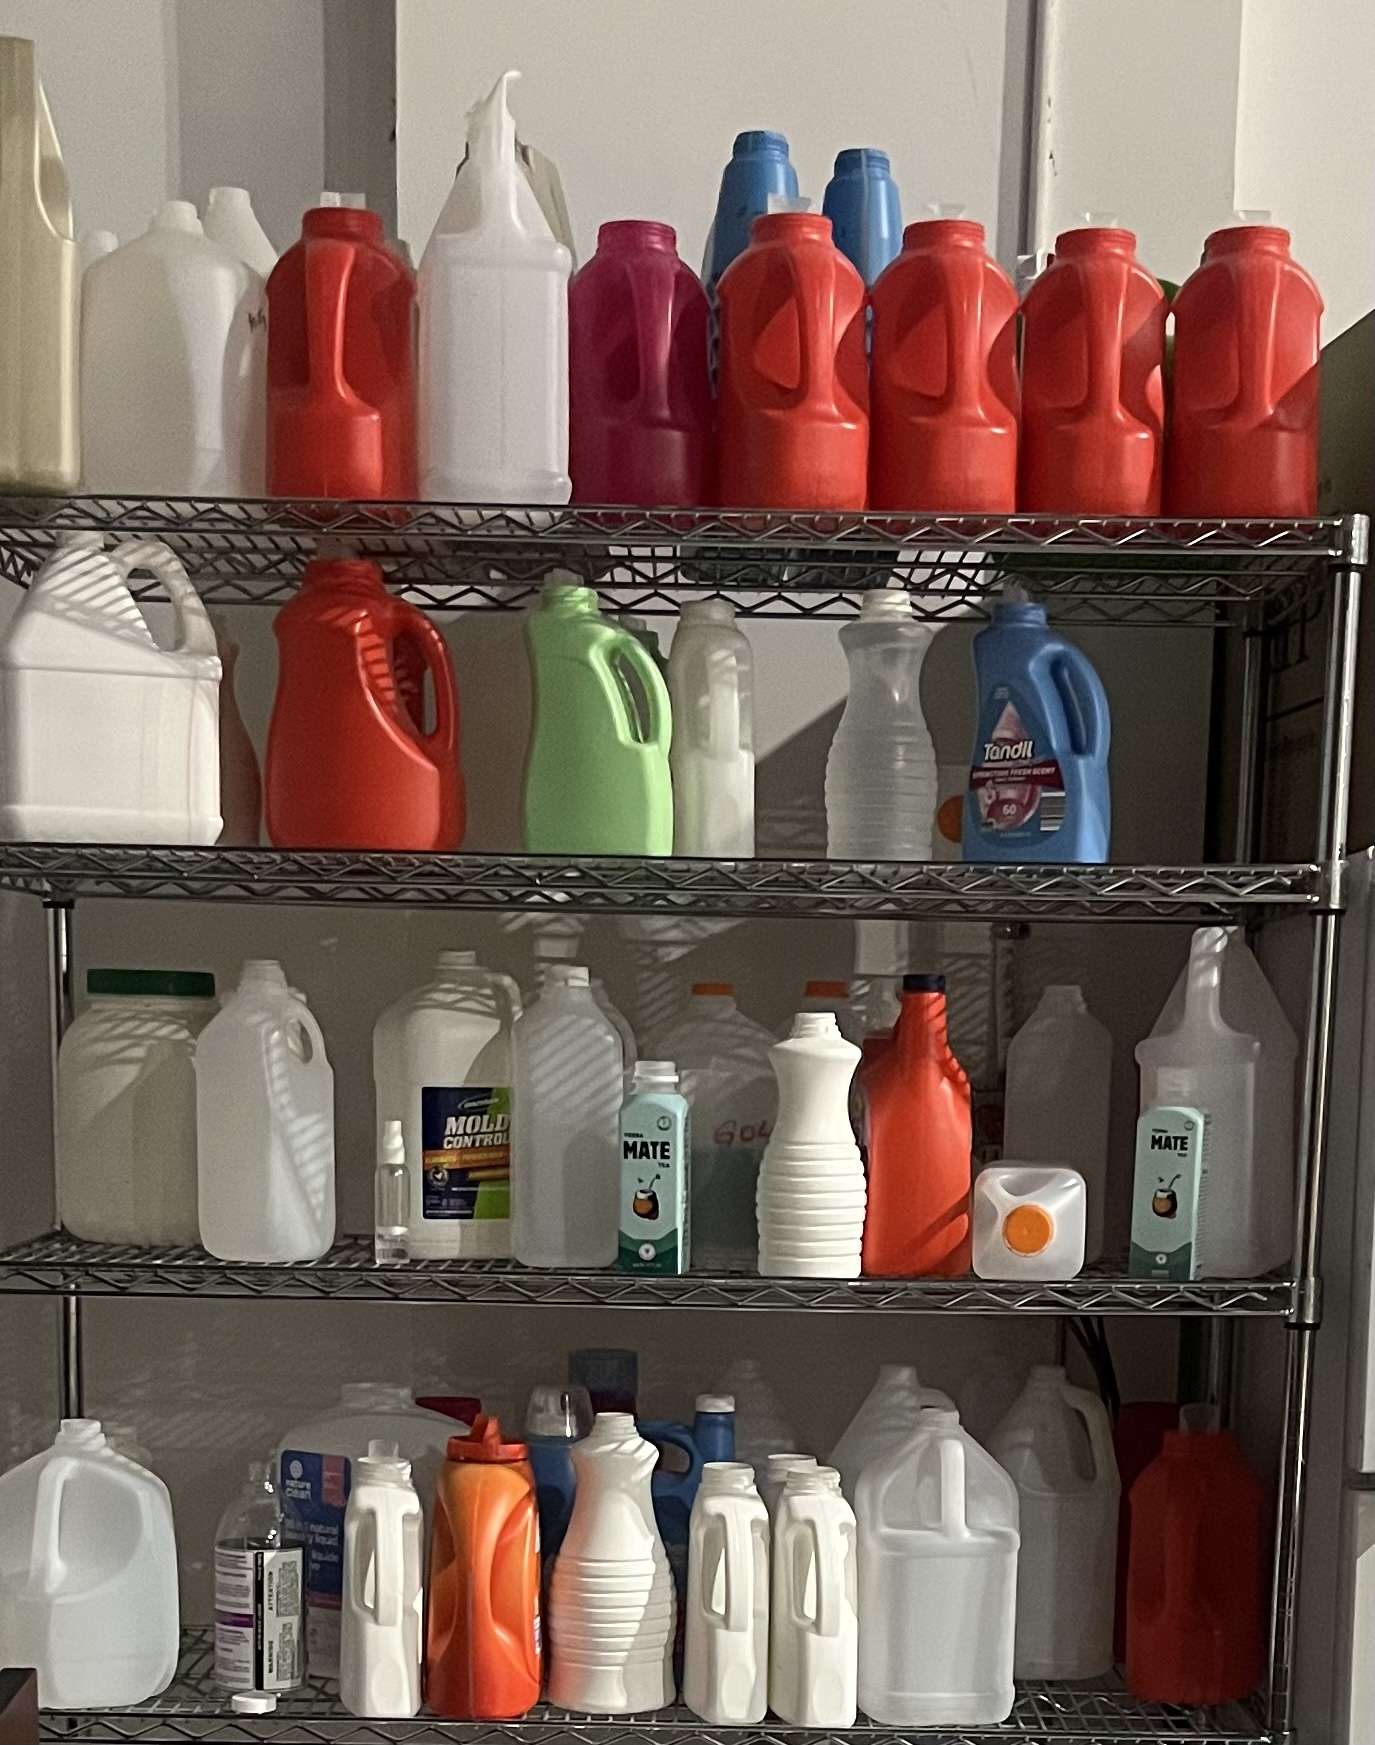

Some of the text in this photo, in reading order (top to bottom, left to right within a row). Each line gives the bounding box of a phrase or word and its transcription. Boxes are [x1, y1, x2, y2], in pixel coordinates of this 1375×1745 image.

[984, 740, 1033, 761] Tandil
[1002, 804, 1017, 815] 60
[444, 1114, 511, 1135] MOLD
[623, 1140, 671, 1160] MATE
[1150, 1134, 1189, 1151] MATE
